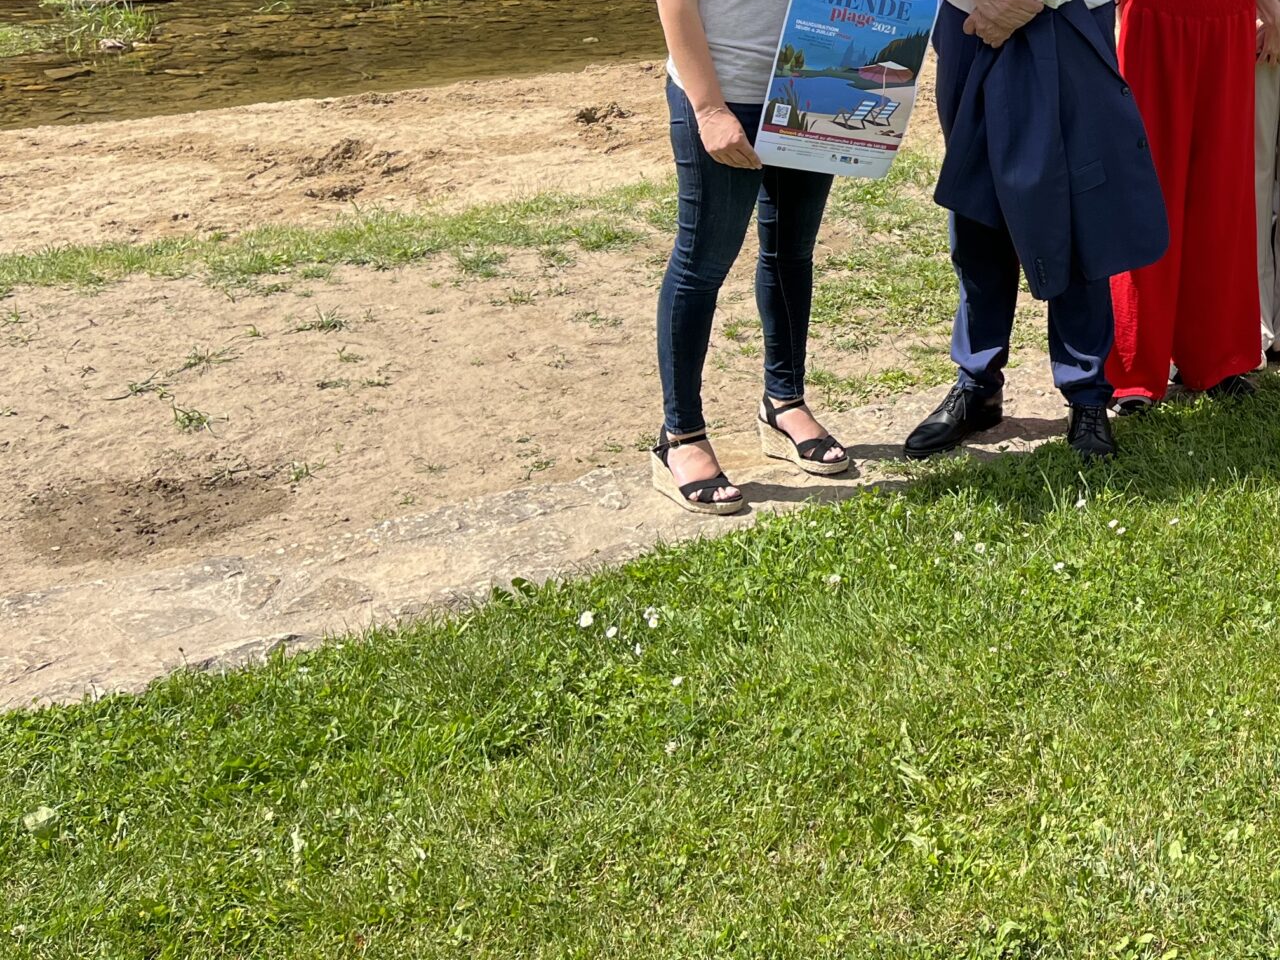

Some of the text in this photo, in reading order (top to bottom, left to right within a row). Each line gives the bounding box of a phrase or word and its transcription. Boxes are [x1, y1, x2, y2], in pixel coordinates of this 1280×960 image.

[830, 7, 875, 28] plage
[795, 24, 810, 32] JEUDI
[815, 29, 836, 37] JUILLET
[796, 19, 839, 32] INAUGURATION
[872, 22, 897, 35] 2024
[826, 135, 849, 144] dimanche
